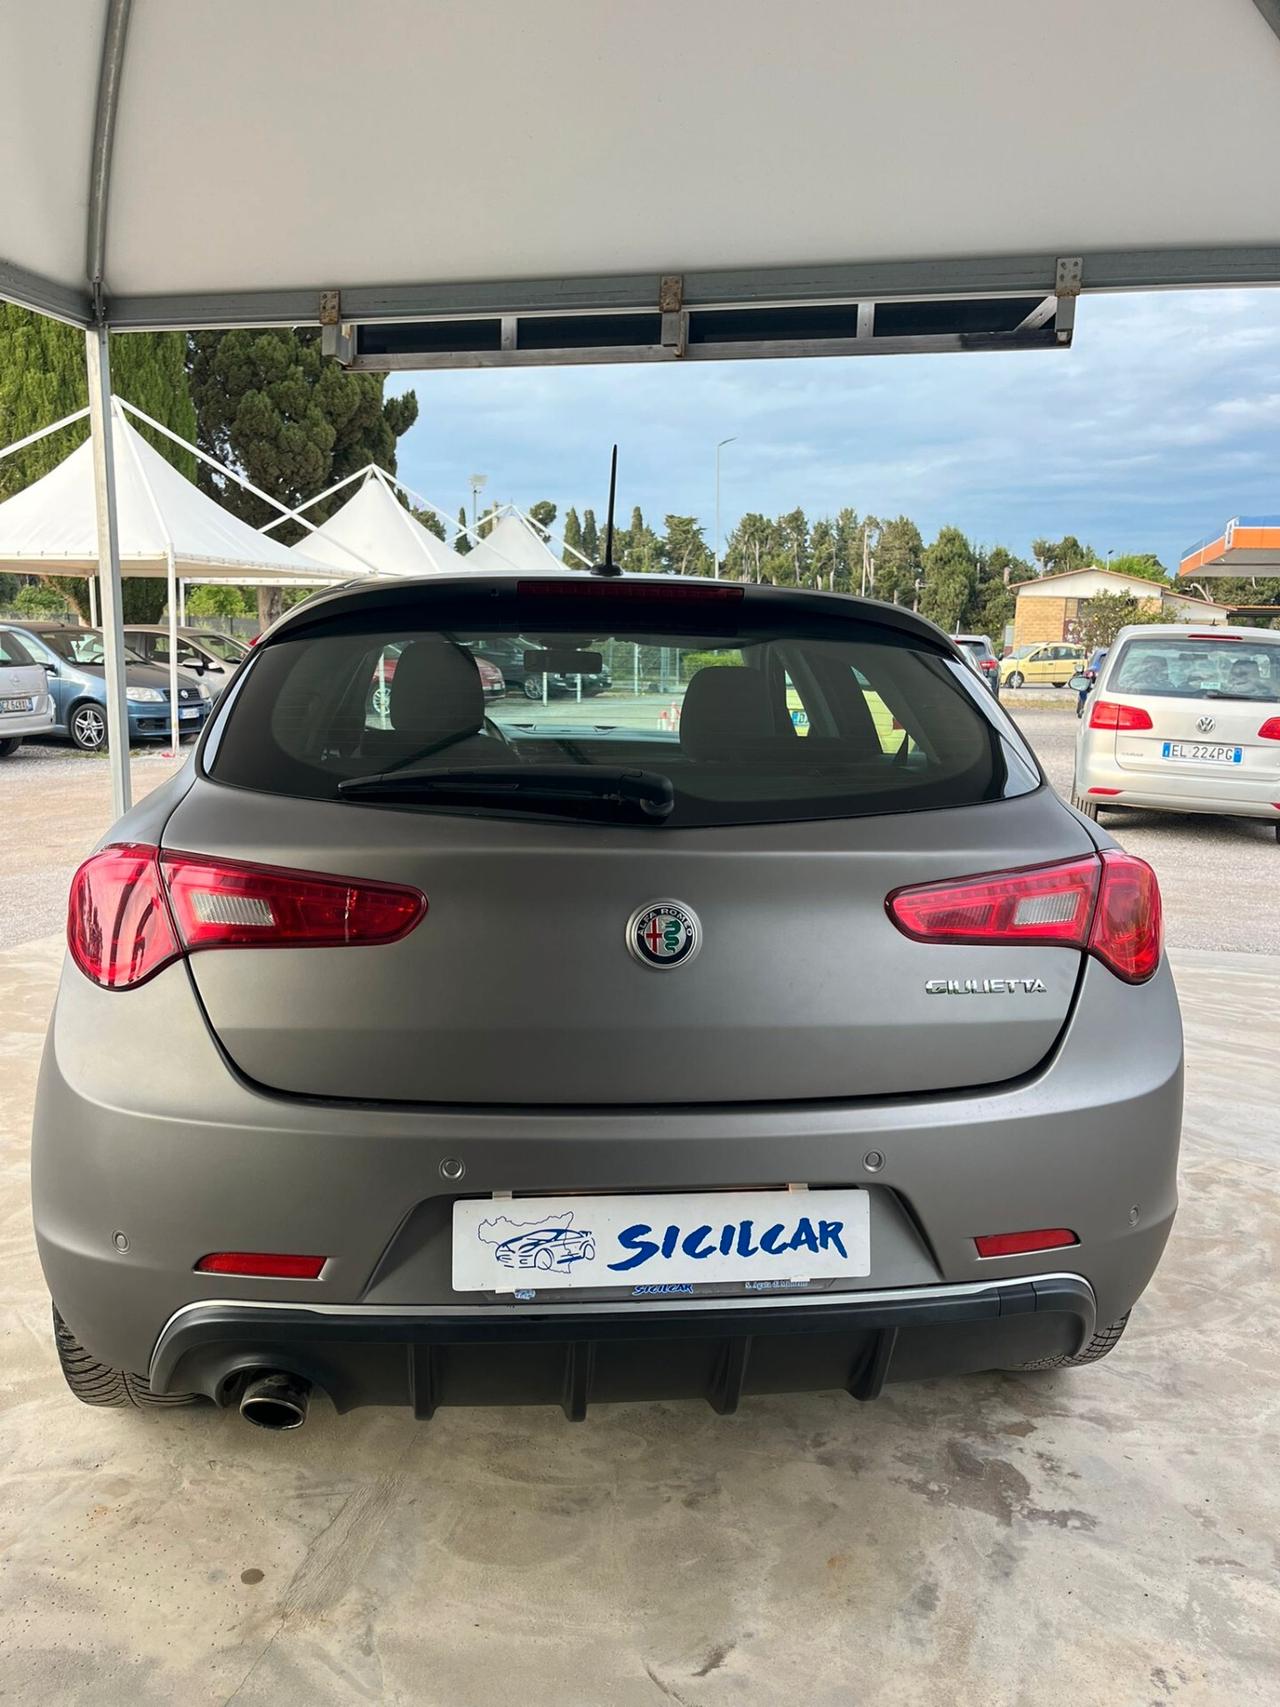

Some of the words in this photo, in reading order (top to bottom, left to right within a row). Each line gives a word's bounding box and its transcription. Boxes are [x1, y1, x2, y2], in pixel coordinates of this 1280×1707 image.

[1171, 744, 1187, 758] EL
[1192, 746, 1233, 760] 224PG
[637, 912, 658, 937] ALFA
[660, 908, 694, 937] ROMEO
[925, 978, 1048, 995] GIULIETTA
[607, 1217, 848, 1271] SICILCAR
[631, 1283, 694, 1296] SICILCAR
